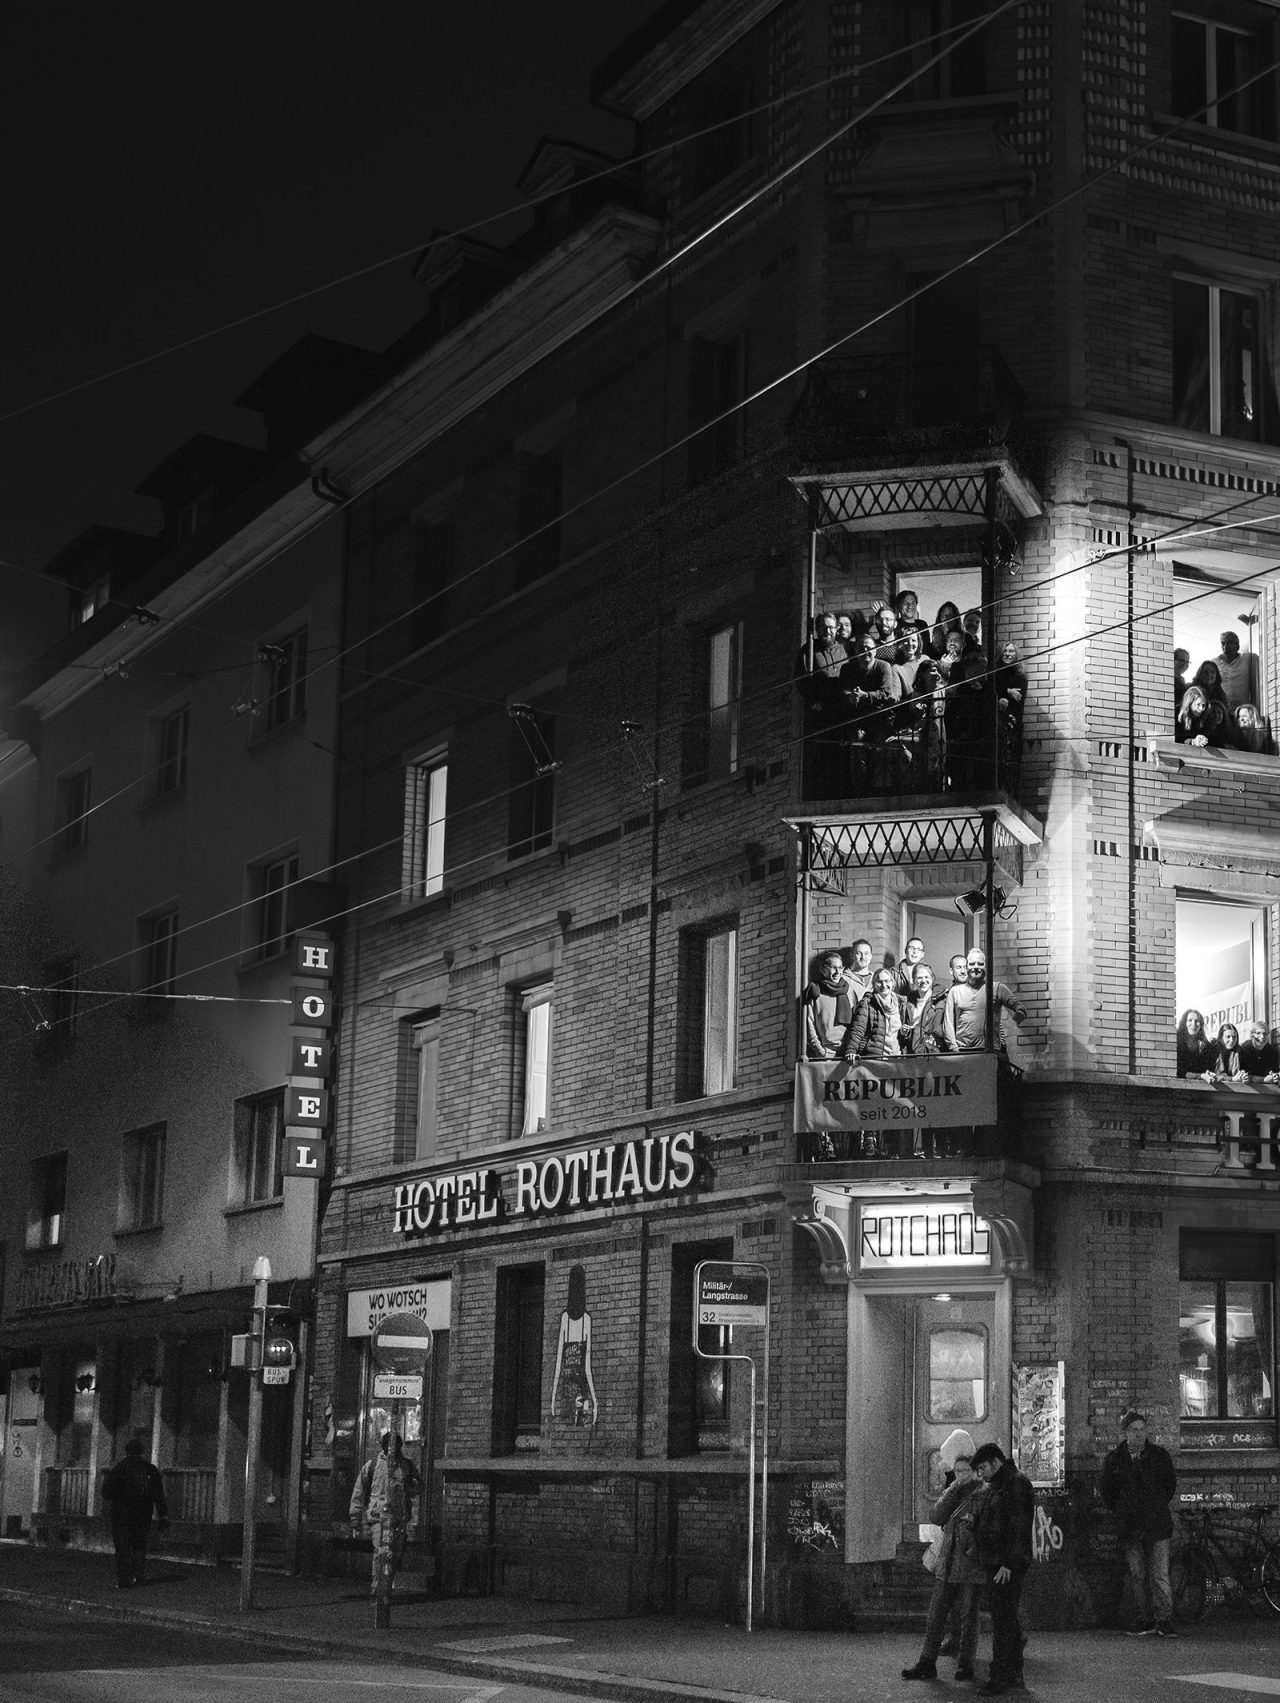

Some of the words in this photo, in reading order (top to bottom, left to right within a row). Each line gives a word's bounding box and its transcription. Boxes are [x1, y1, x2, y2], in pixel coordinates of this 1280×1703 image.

[297, 946, 329, 1168] HOTEL
[823, 1074, 963, 1101] REPUBLIK
[860, 1107, 887, 1120] seit
[891, 1106, 927, 1120] 2018
[393, 1169, 498, 1233] HOTEL
[516, 1130, 696, 1214] ROTHAUS
[861, 1213, 990, 1257] ROTCHAOS
[369, 1294, 385, 1309] WO
[387, 1288, 427, 1308] WOTSCH
[702, 1291, 749, 1301] Langstrasse
[702, 1312, 716, 1322] 32
[389, 1385, 407, 1395] BUS
